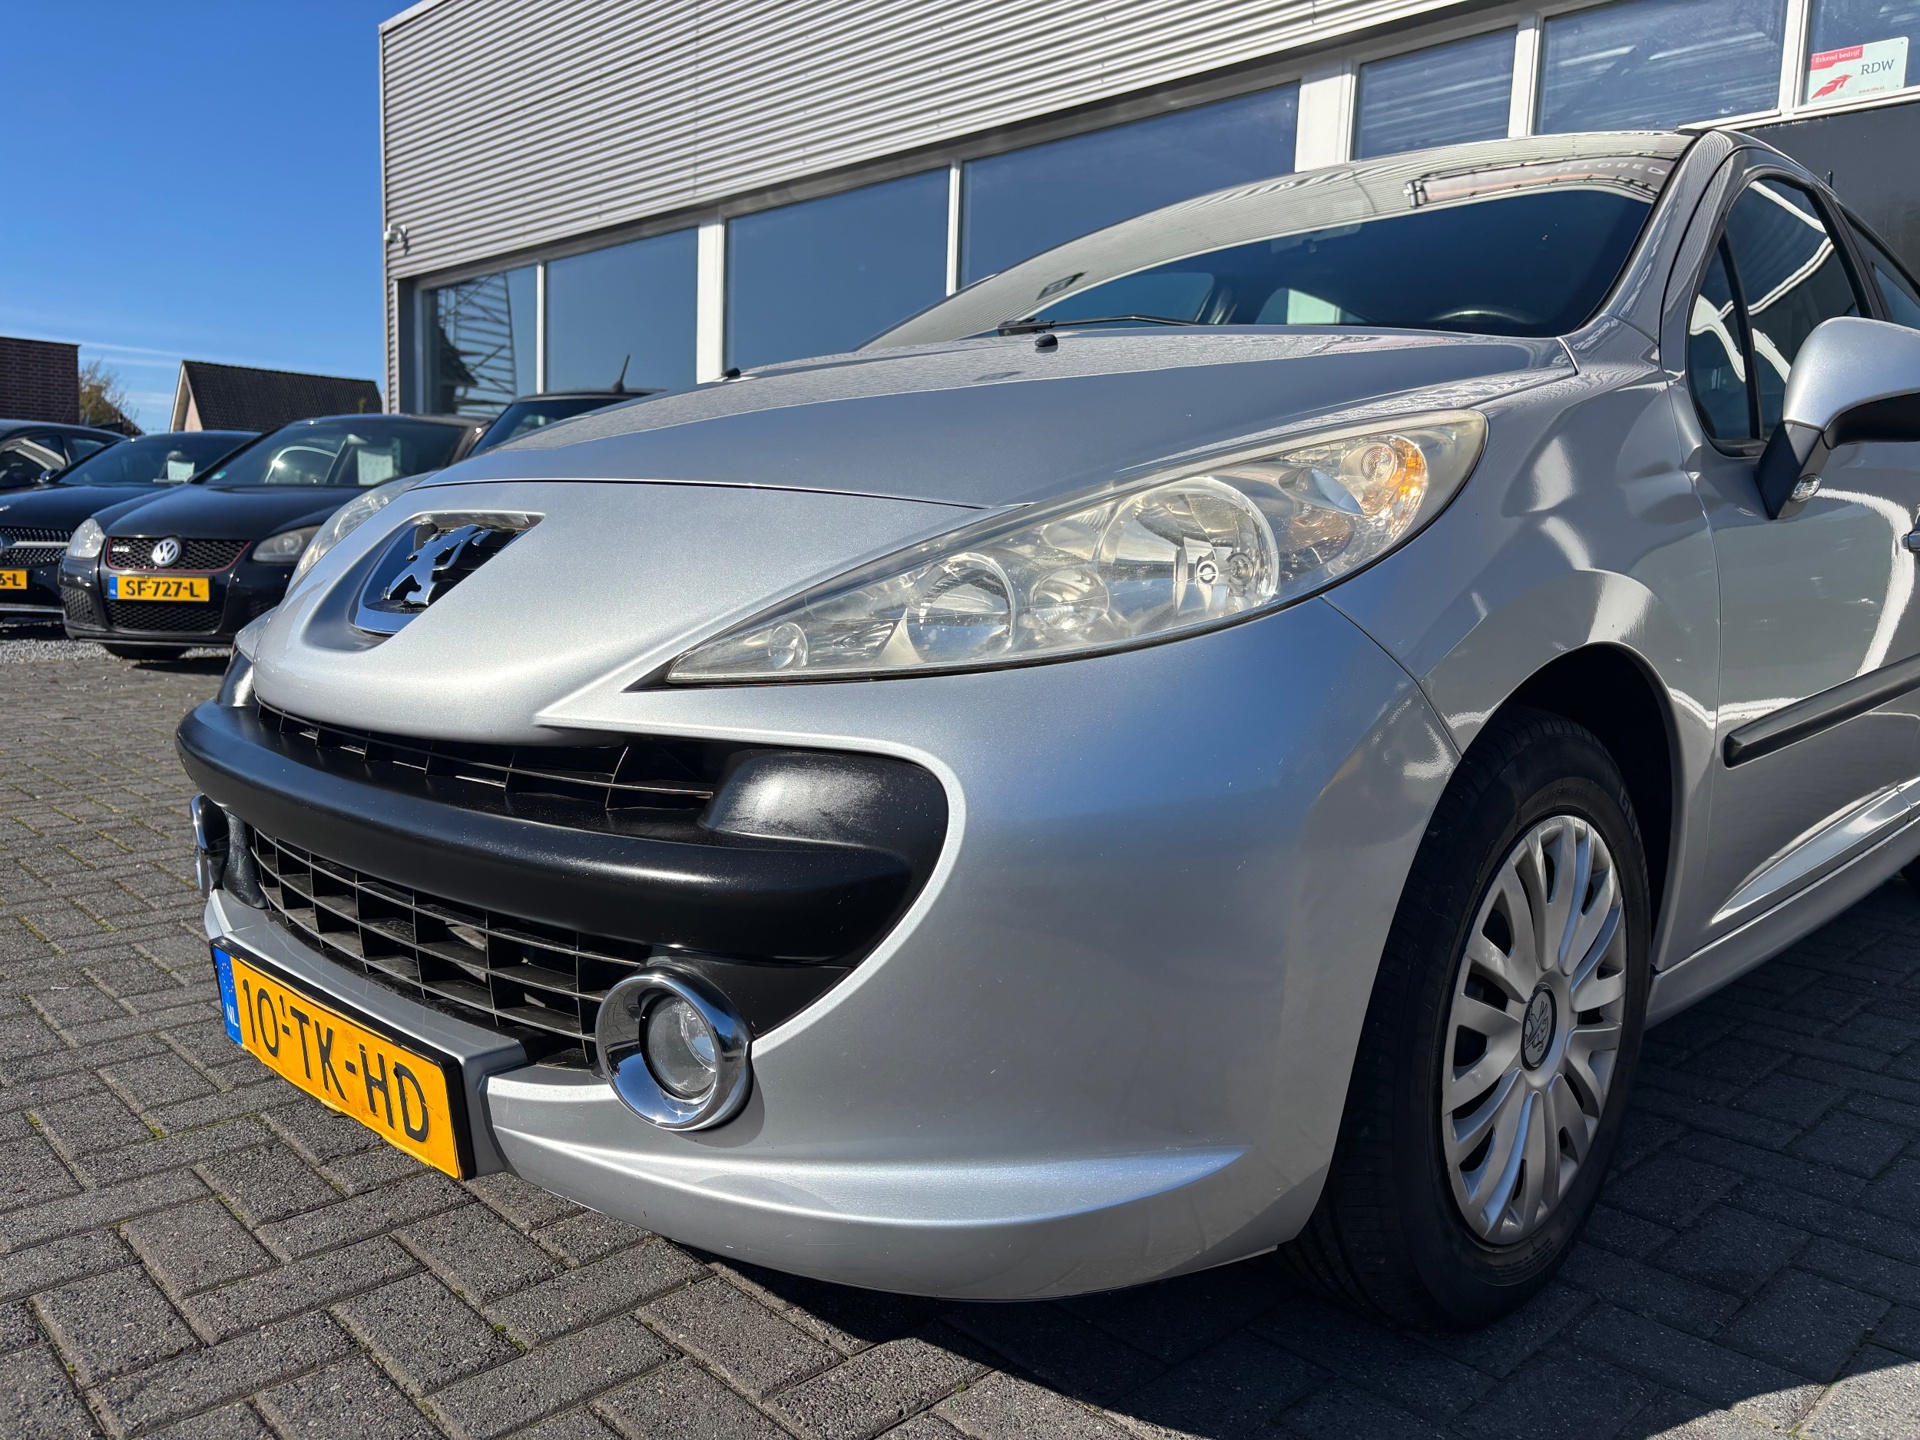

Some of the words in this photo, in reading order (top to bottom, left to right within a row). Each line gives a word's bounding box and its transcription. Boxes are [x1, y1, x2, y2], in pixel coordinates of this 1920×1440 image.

[1815, 54, 1838, 64] Erkend
[1838, 49, 1861, 59] bedrijf
[1860, 59, 1895, 76] RDW
[126, 580, 200, 598] SF-727-L
[226, 1002, 239, 1027] NL
